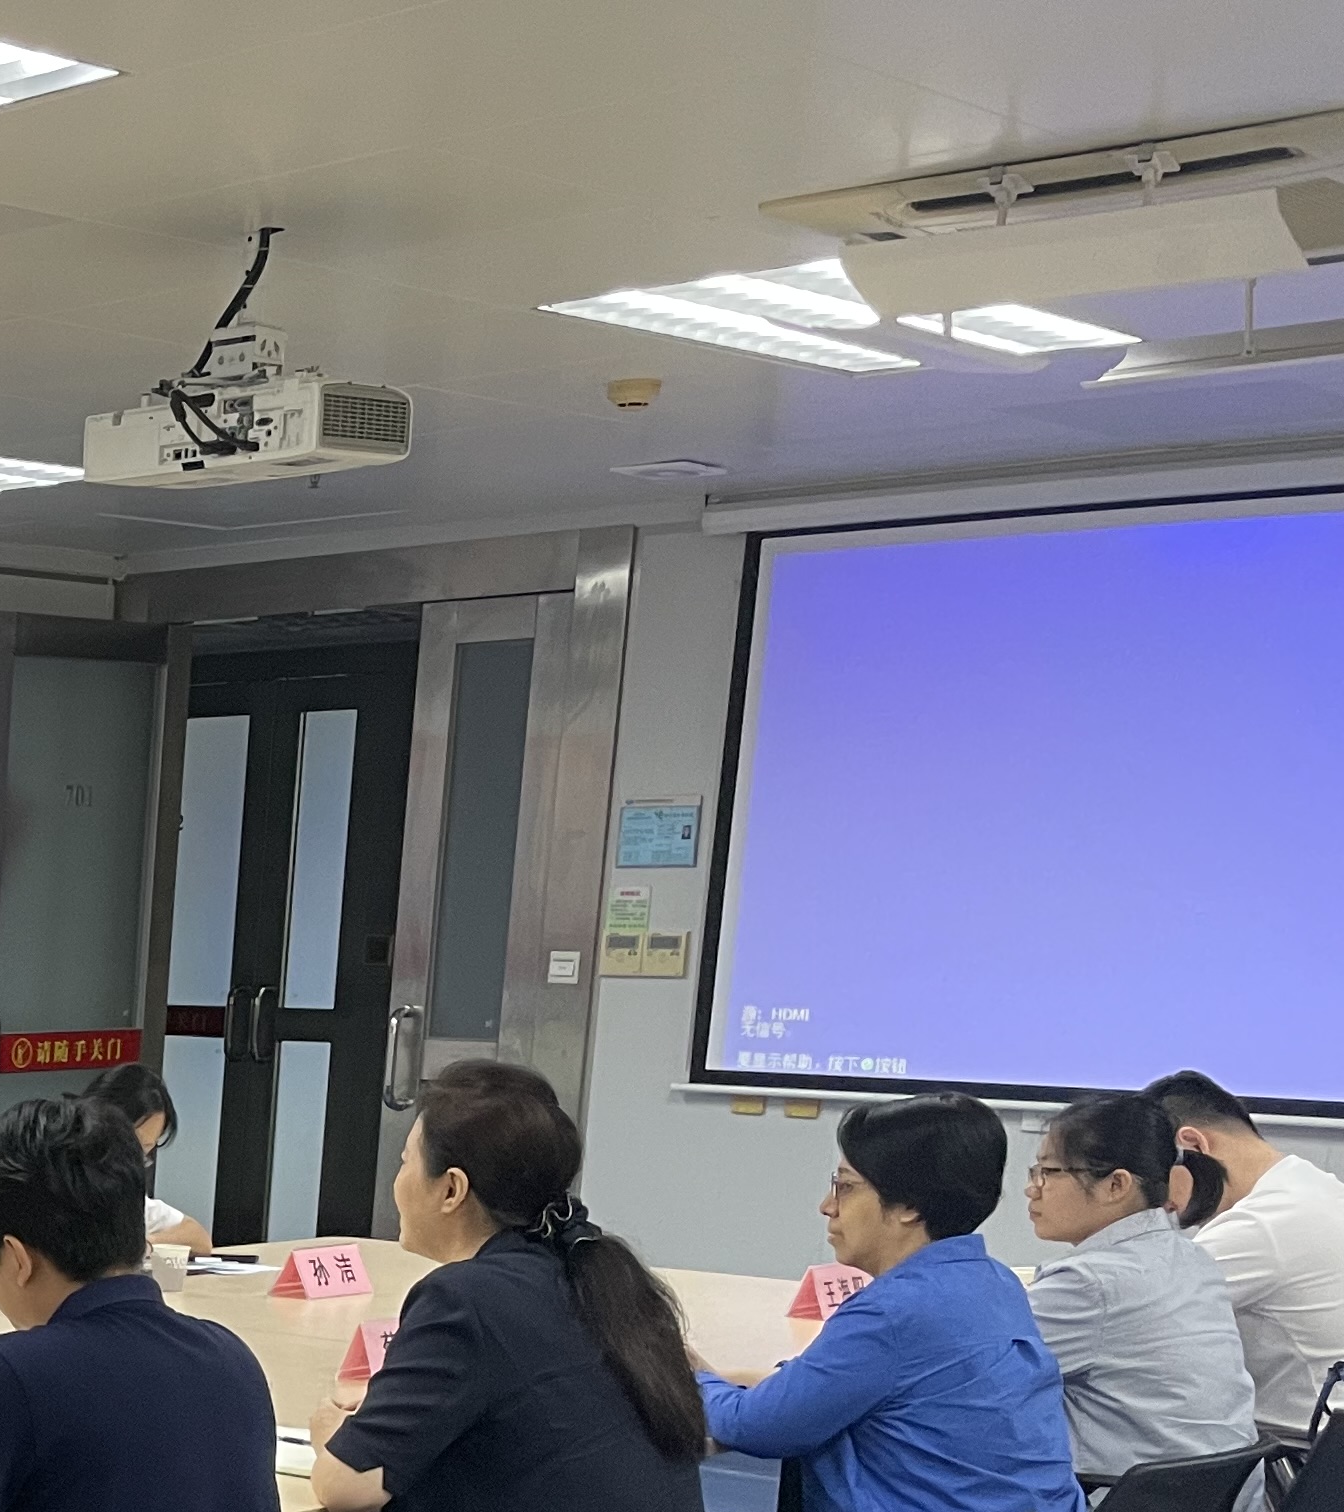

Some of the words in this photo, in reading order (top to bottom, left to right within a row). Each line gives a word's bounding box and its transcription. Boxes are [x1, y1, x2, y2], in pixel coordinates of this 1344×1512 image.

[771, 1007, 810, 1022] HDMI
[36, 1038, 121, 1063] 请随手关门
